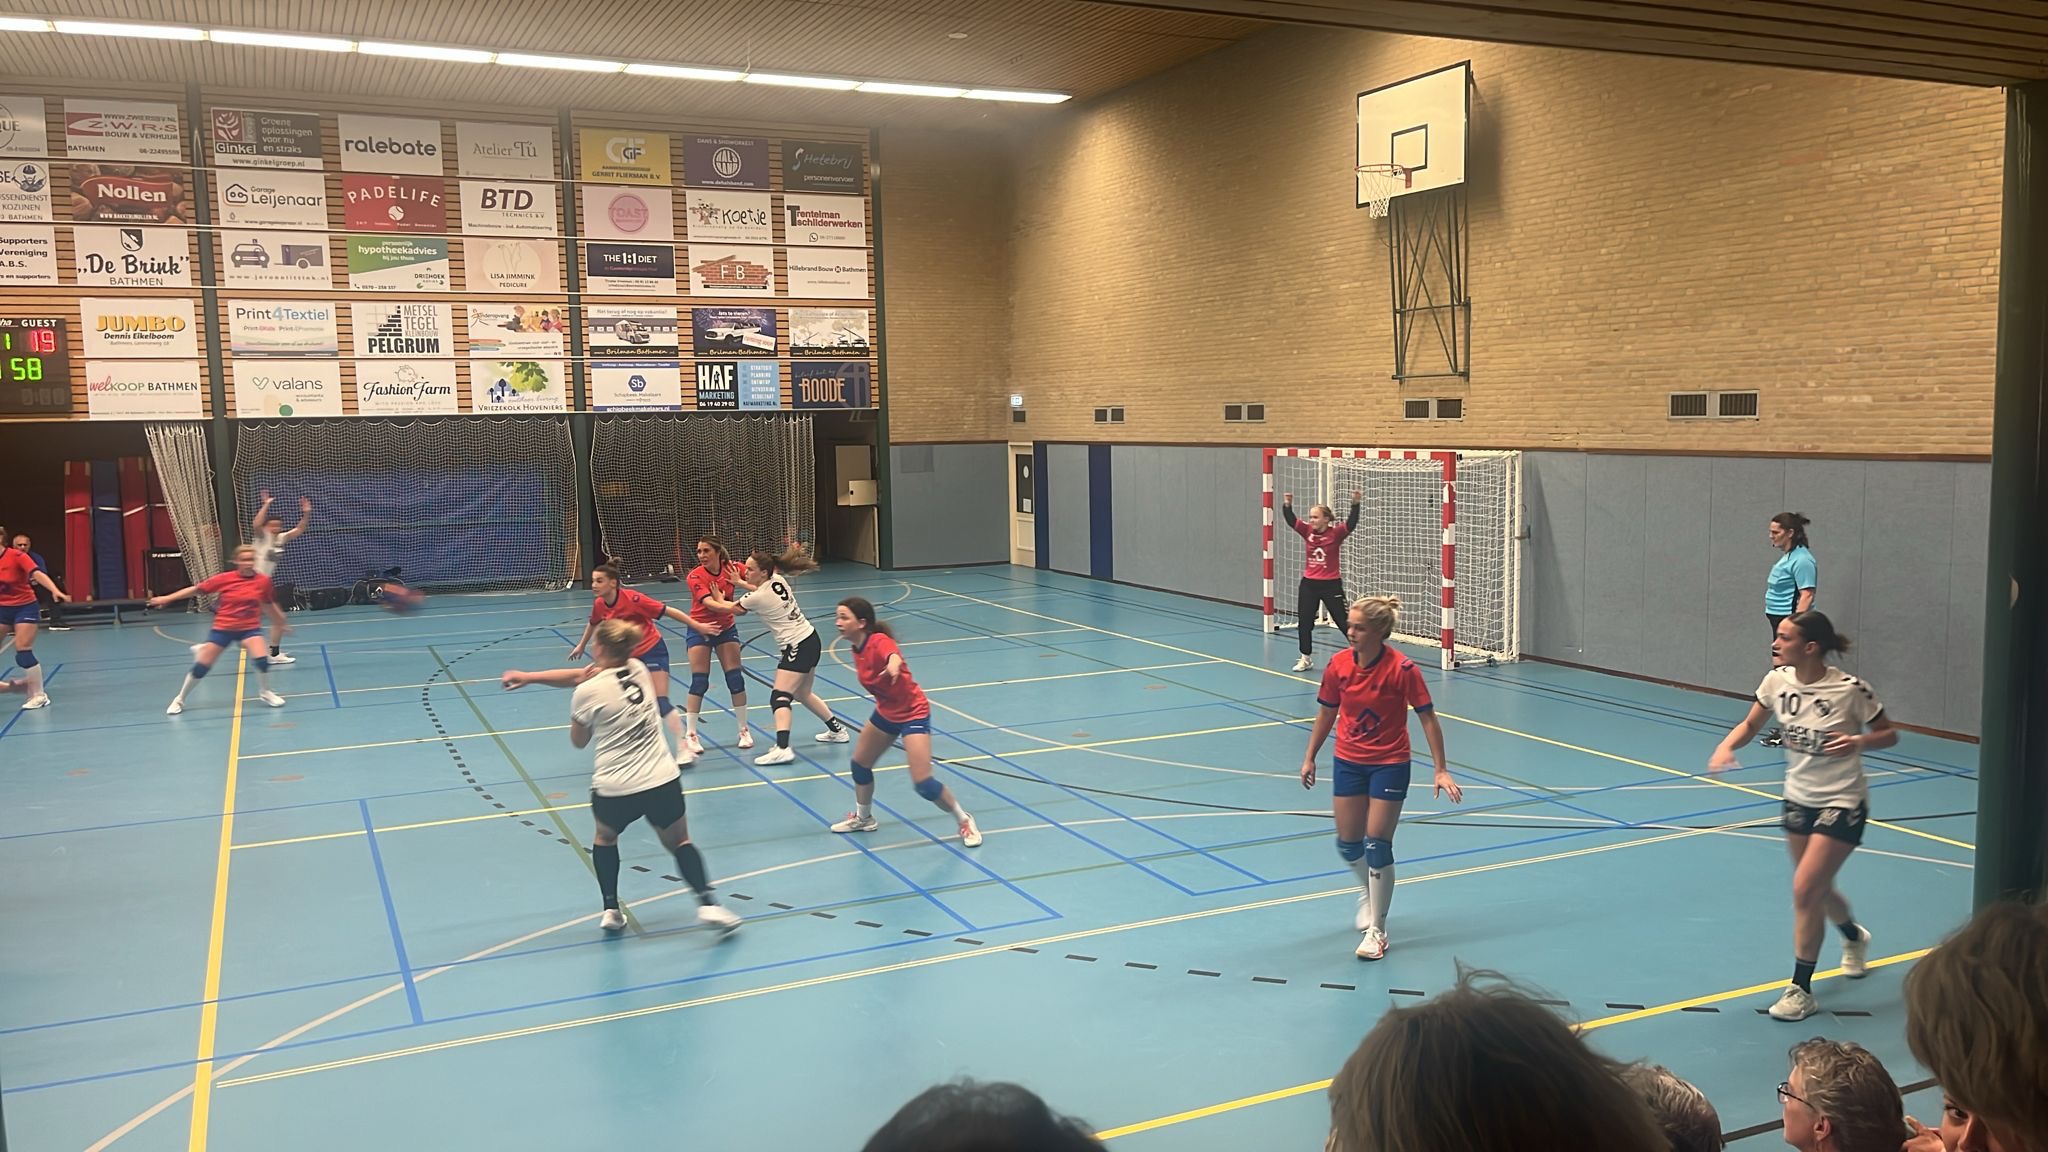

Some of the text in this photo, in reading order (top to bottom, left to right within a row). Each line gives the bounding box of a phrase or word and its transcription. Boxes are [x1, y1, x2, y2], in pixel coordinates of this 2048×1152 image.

[261, 127, 313, 138] oplossingen
[216, 142, 257, 154] Ginkel
[345, 136, 437, 156] ralebate
[472, 143, 513, 156] Atelier
[97, 183, 167, 202] Nollen
[347, 186, 441, 207] PADELIFE
[480, 188, 534, 210] BTD
[251, 194, 323, 208] Leijenaar
[722, 208, 767, 226] Koetje
[797, 218, 863, 228] schilderwerken
[358, 245, 438, 255] hypotheekadvies
[603, 252, 657, 264] THE 1:1 DIET
[109, 277, 164, 286] BATHMEN
[403, 305, 438, 317] METSEL
[21, 319, 57, 327] GUEST
[96, 315, 186, 332] JUMBO
[403, 317, 439, 331] TEGEL
[32, 330, 55, 352] 19
[132, 332, 175, 340] Eikelboom
[367, 338, 440, 353] PELGRUM
[272, 377, 323, 390] valans
[631, 379, 644, 388] Sb
[697, 365, 734, 390] HAF
[148, 382, 198, 391] BATHMEN
[799, 378, 847, 403] BOODE
[699, 392, 735, 400] MARKETING
[771, 581, 789, 601] 9
[616, 669, 644, 705] 5
[1778, 691, 1801, 716] 10
